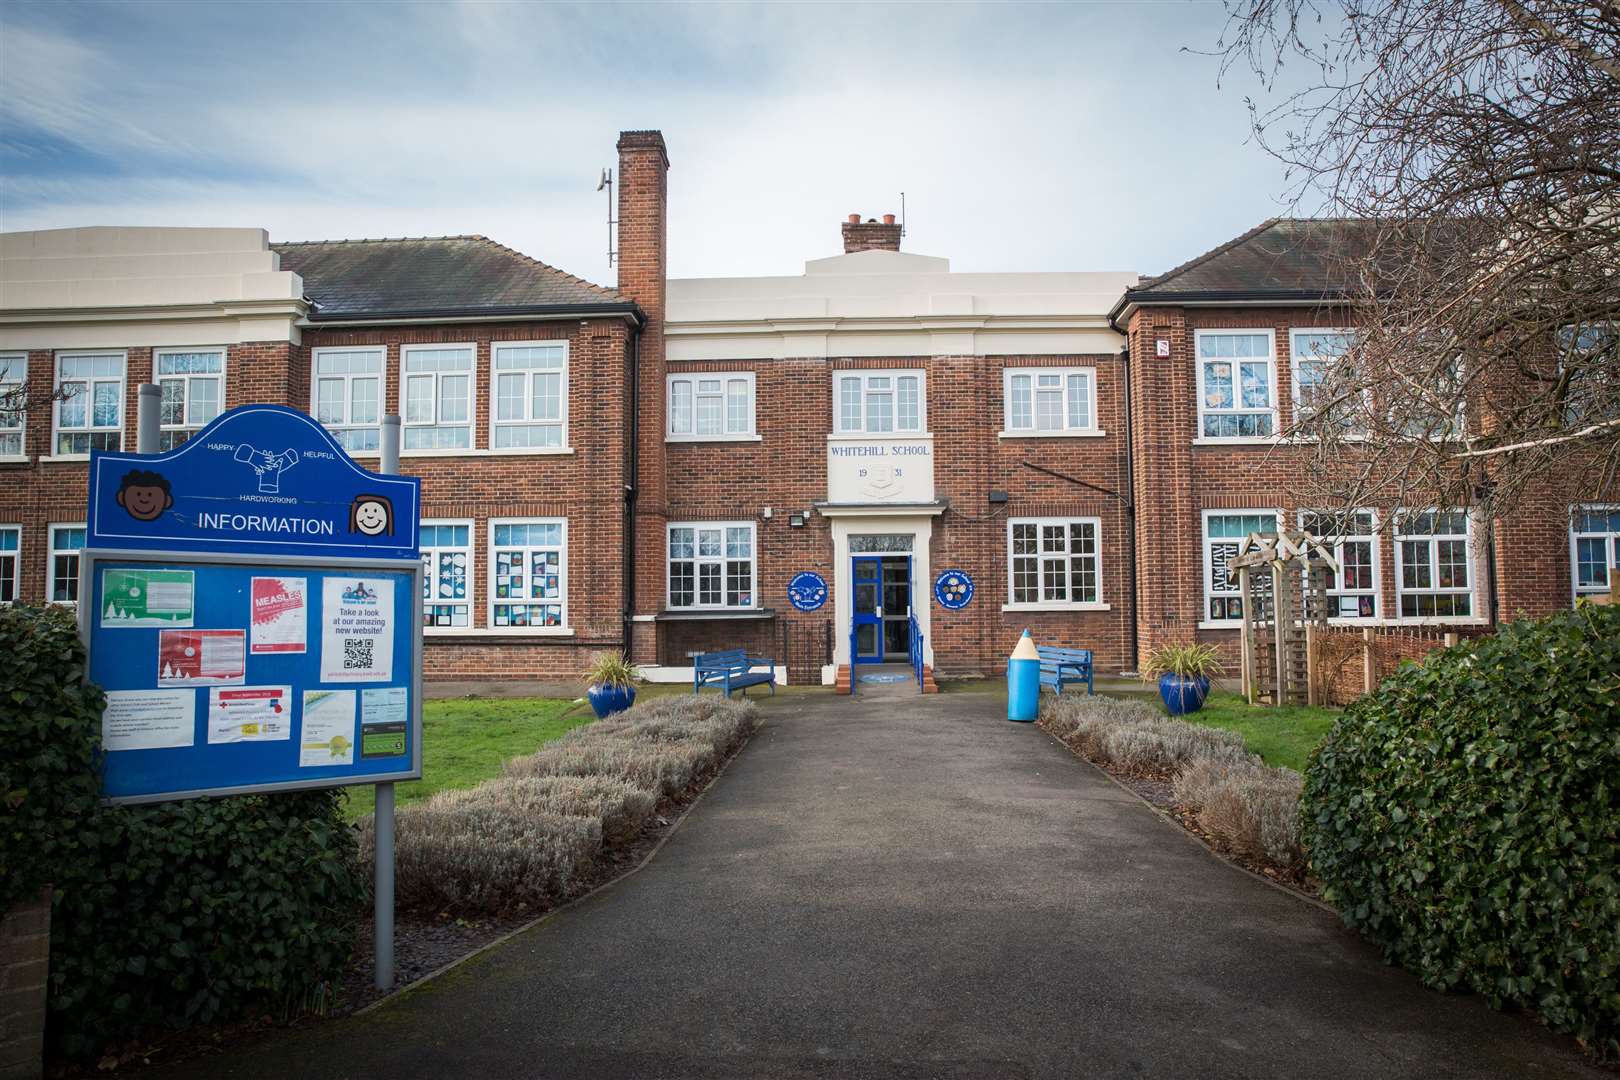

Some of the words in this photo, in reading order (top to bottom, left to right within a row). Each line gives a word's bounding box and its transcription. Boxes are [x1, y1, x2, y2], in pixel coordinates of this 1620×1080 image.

[207, 443, 234, 451] HAPPY
[831, 446, 888, 456] WHITEHILL
[892, 446, 929, 455] SCHOOL
[303, 451, 335, 460] HELPFUL
[240, 494, 297, 504] HARDWORKING
[198, 512, 334, 535] INFORMATION
[256, 591, 302, 606] MEASLES
[340, 608, 356, 616] Take
[364, 609, 379, 617] look
[356, 618, 385, 628] amazing
